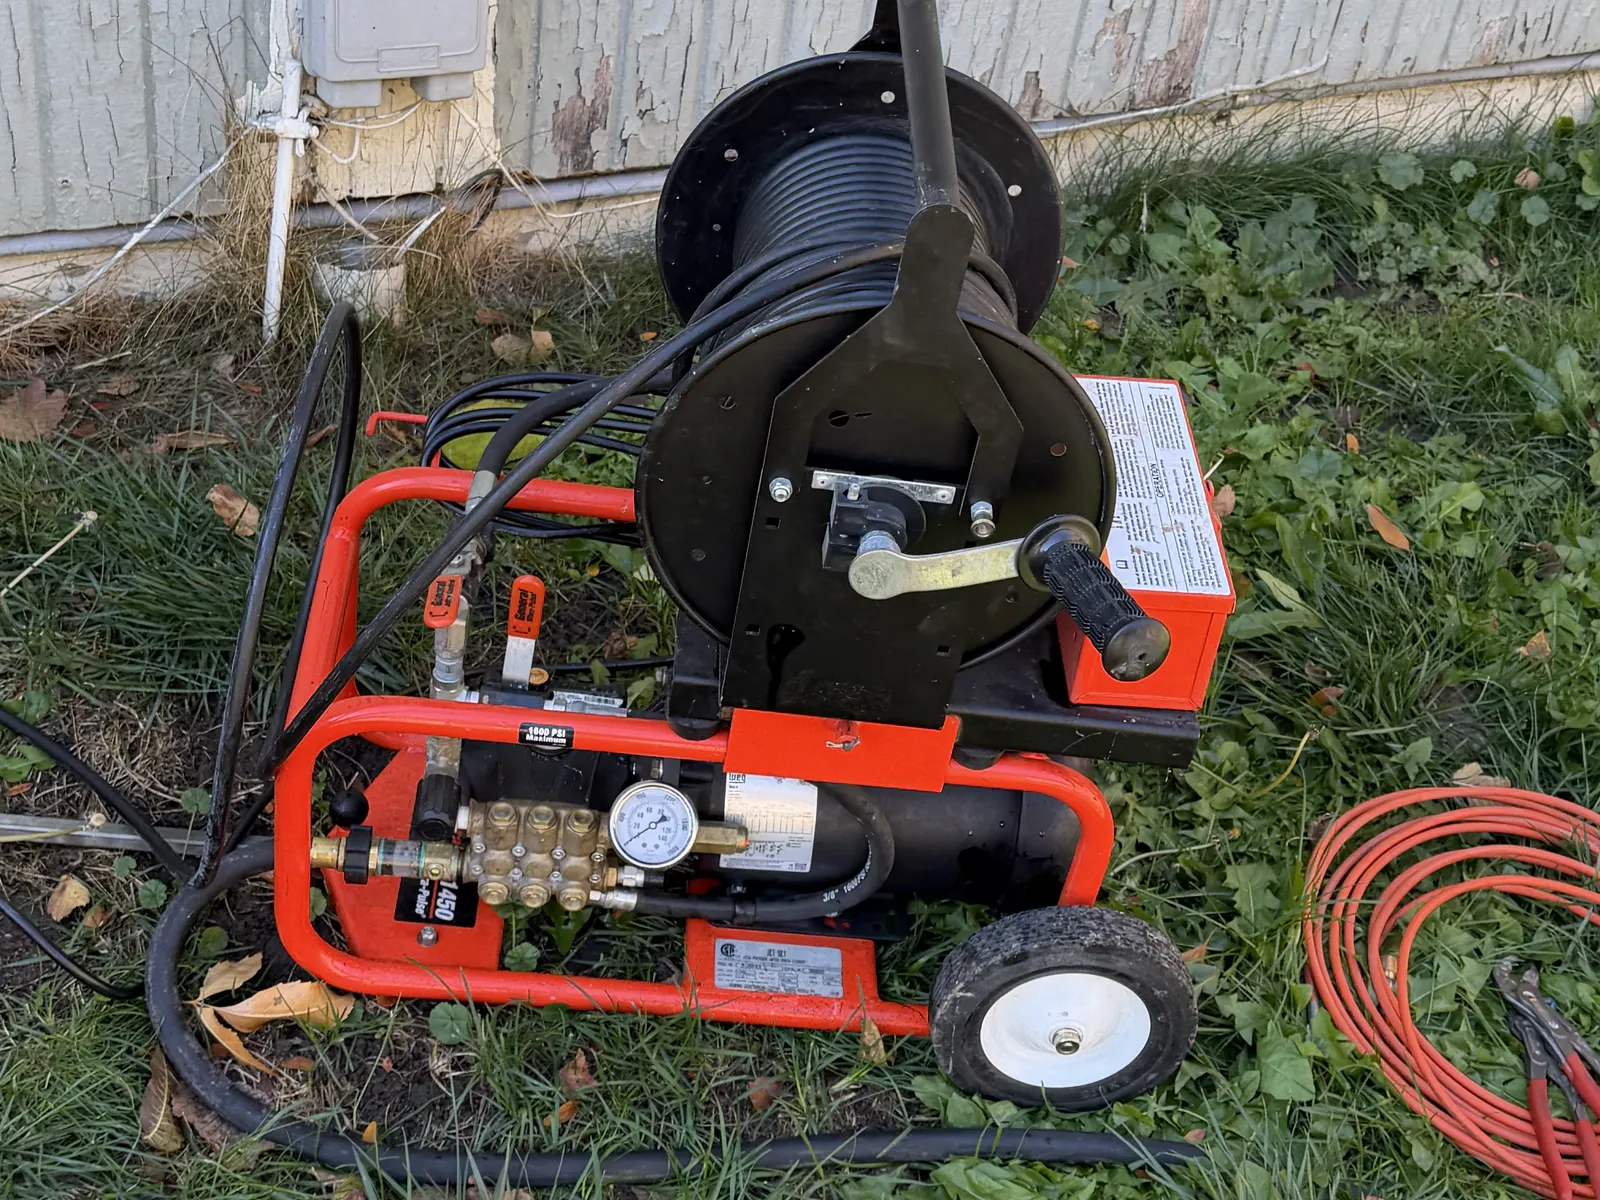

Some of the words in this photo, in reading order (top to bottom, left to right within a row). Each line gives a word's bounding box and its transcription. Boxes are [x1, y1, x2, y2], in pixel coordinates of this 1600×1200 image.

[1150, 463, 1164, 498] OPERATION
[514, 588, 528, 621] General
[525, 733, 567, 744] Maximum
[528, 726, 550, 736] 1600
[551, 728, 566, 738] PSI
[435, 881, 459, 921] 1450
